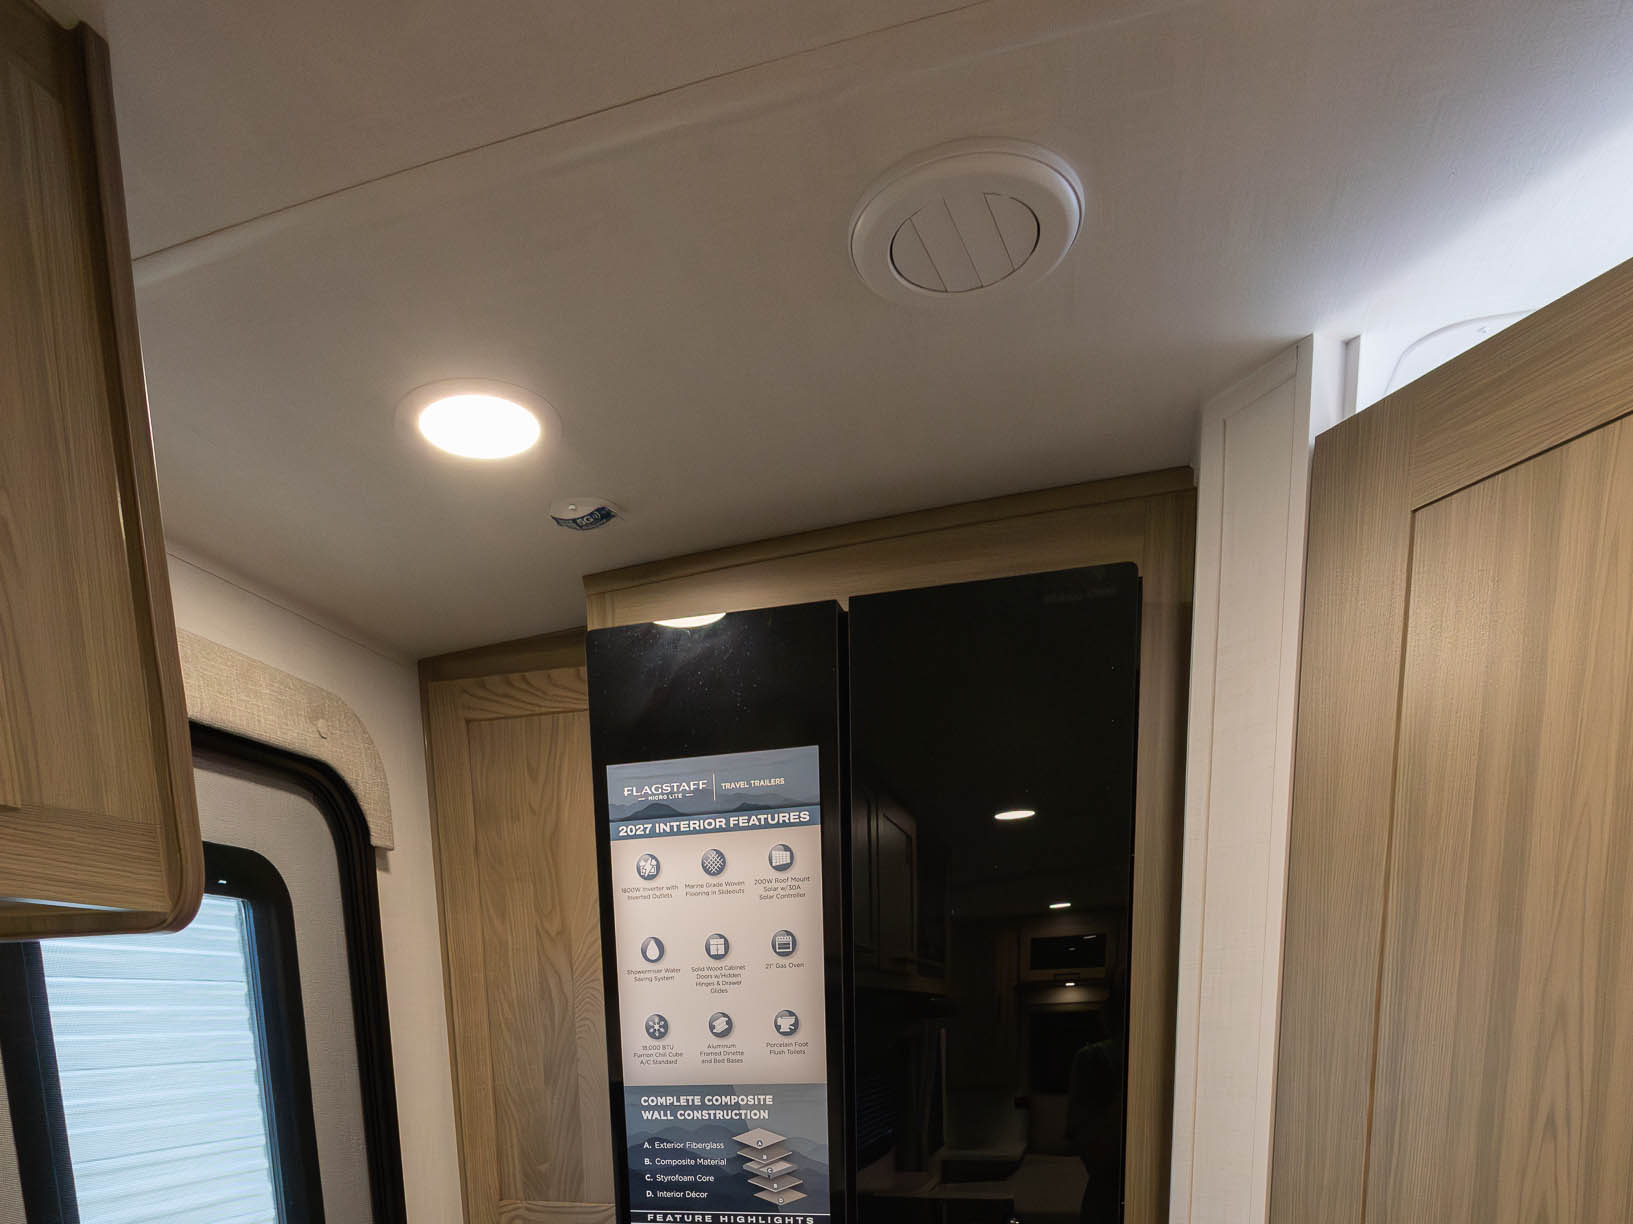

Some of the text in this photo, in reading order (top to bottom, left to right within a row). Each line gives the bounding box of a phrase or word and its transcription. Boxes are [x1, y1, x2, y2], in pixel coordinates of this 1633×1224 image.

[624, 778, 785, 797] FLAGSTAFF TRAVEL TRAILERS
[619, 811, 810, 836] 2027 INTERIOR FEATURES
[776, 892, 806, 900] Controller
[641, 1095, 773, 1106] COMPLETE COMPOSITE
[641, 1110, 769, 1120] WALL CONSTRUCTION
[655, 1141, 684, 1149] Exterior
[686, 1141, 725, 1150] Fiberglass
[655, 1158, 695, 1167] Composite
[697, 1157, 727, 1166] Material
[656, 1174, 694, 1183] Styrofoam
[657, 1190, 684, 1198] Interior
[685, 1190, 708, 1198] Décor
[647, 1214, 814, 1224] FEATURE HIGHLIGHTS
